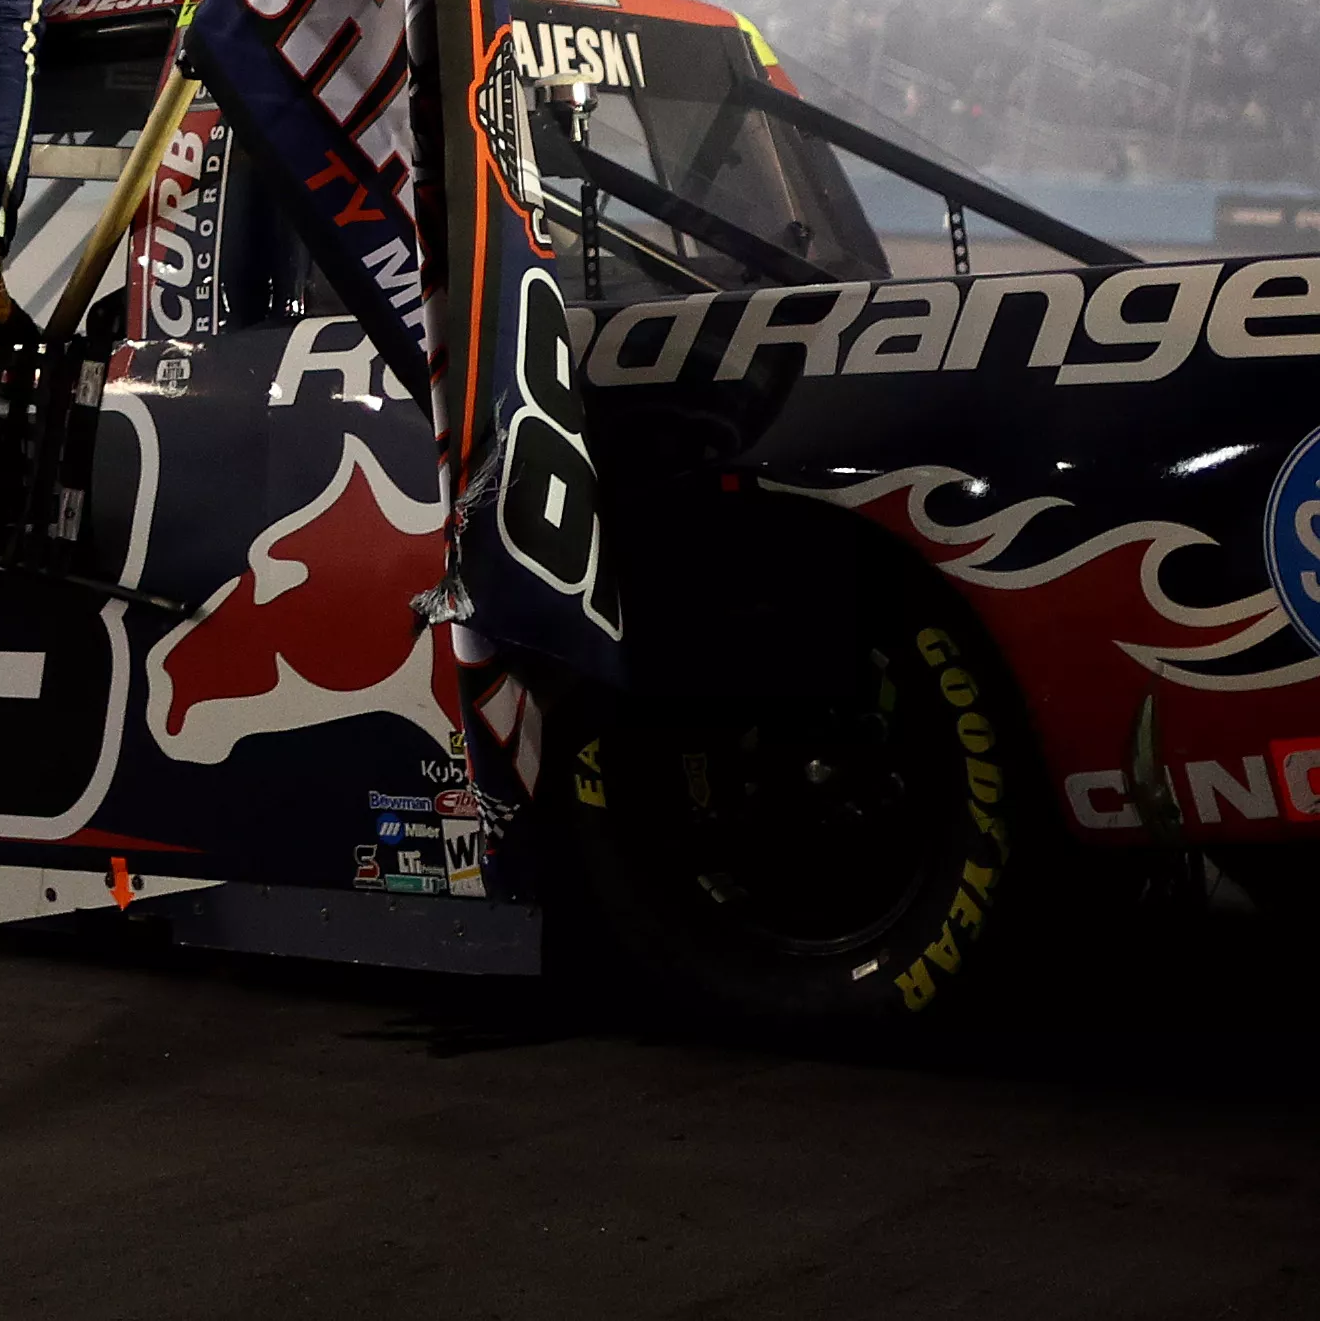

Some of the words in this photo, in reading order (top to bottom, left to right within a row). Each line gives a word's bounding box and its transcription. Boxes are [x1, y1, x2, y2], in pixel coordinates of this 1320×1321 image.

[148, 127, 205, 339] CURB
[194, 124, 226, 333] RECORDS
[305, 149, 386, 230] TY
[368, 790, 433, 812] Bowman
[894, 625, 1012, 1014] GOODYEAR
